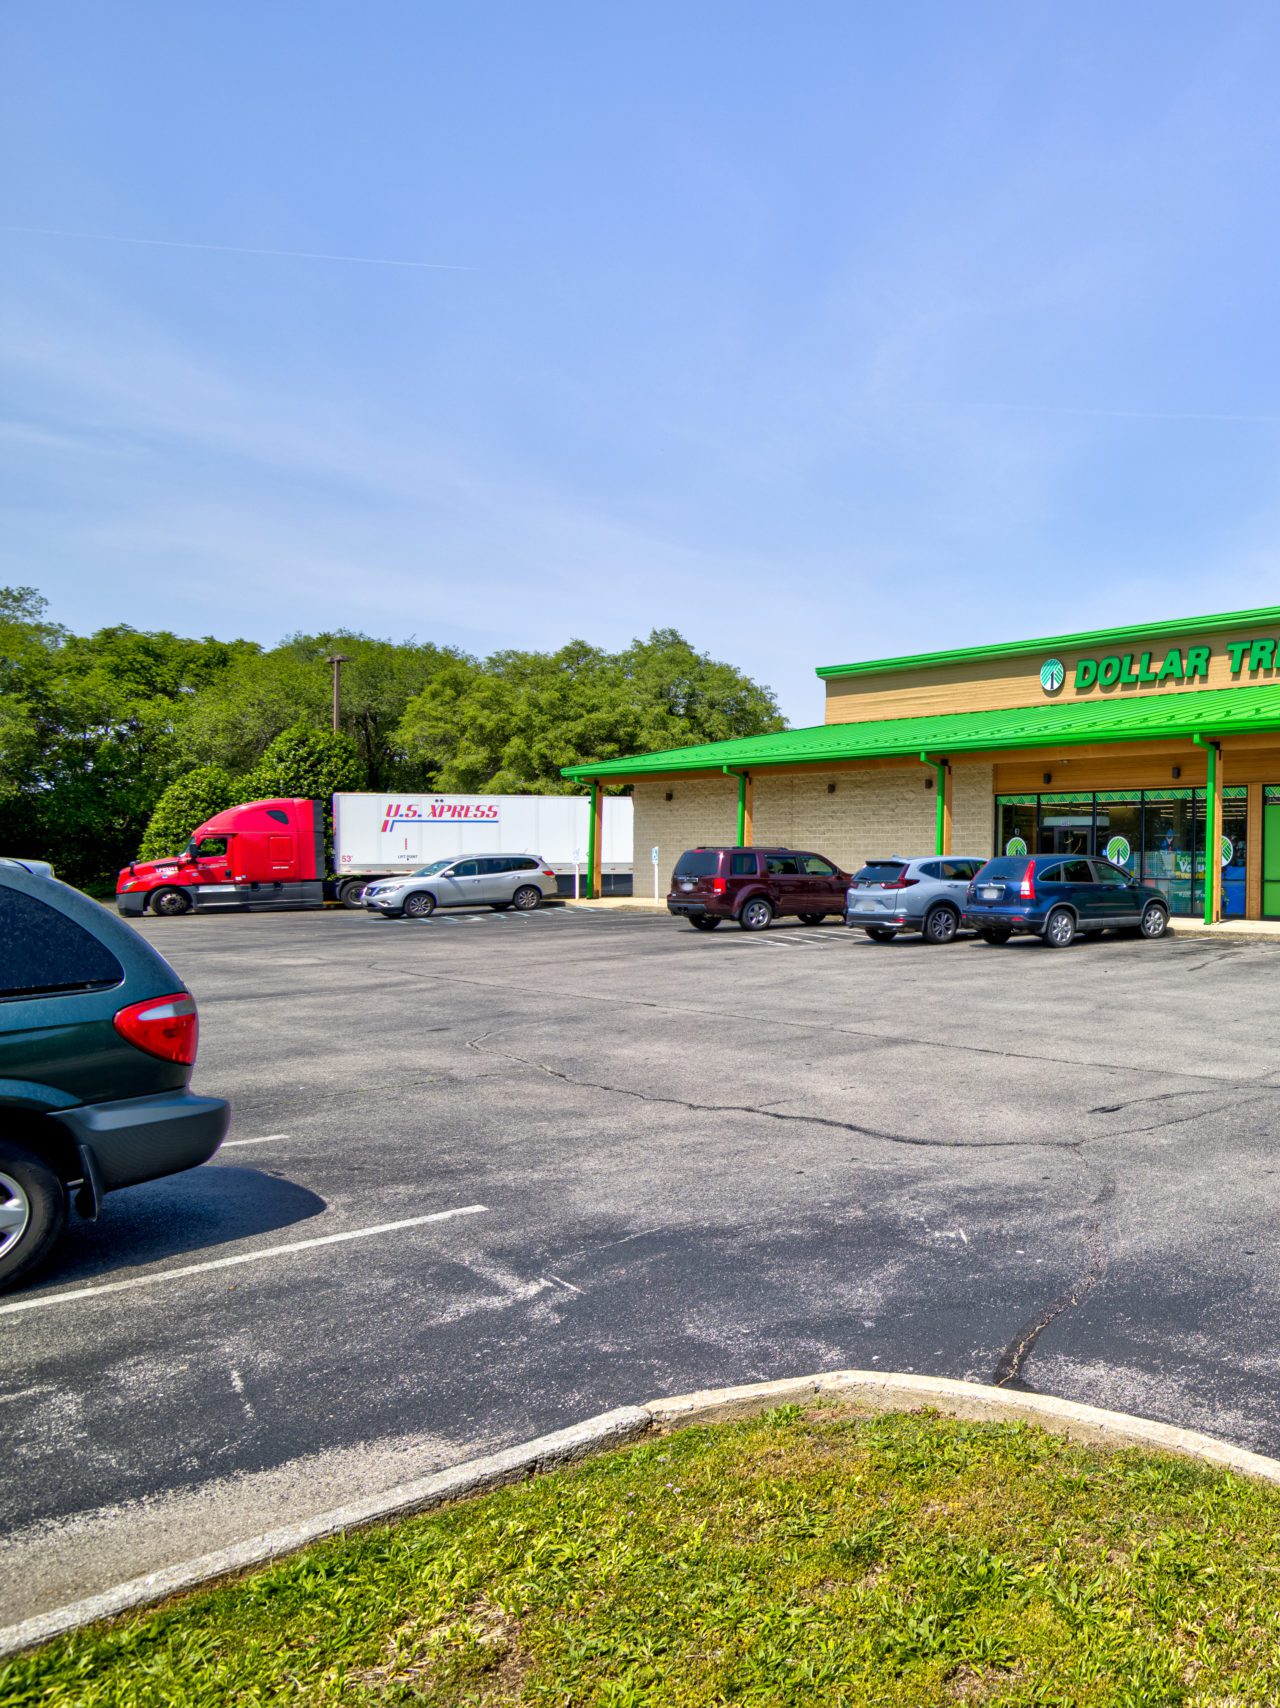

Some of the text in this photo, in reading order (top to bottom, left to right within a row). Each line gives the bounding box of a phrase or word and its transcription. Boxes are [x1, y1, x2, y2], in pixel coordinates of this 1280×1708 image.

[1074, 646, 1211, 688] DOLLAR
[385, 804, 422, 818] U.S.
[1179, 861, 1206, 873] Valu
